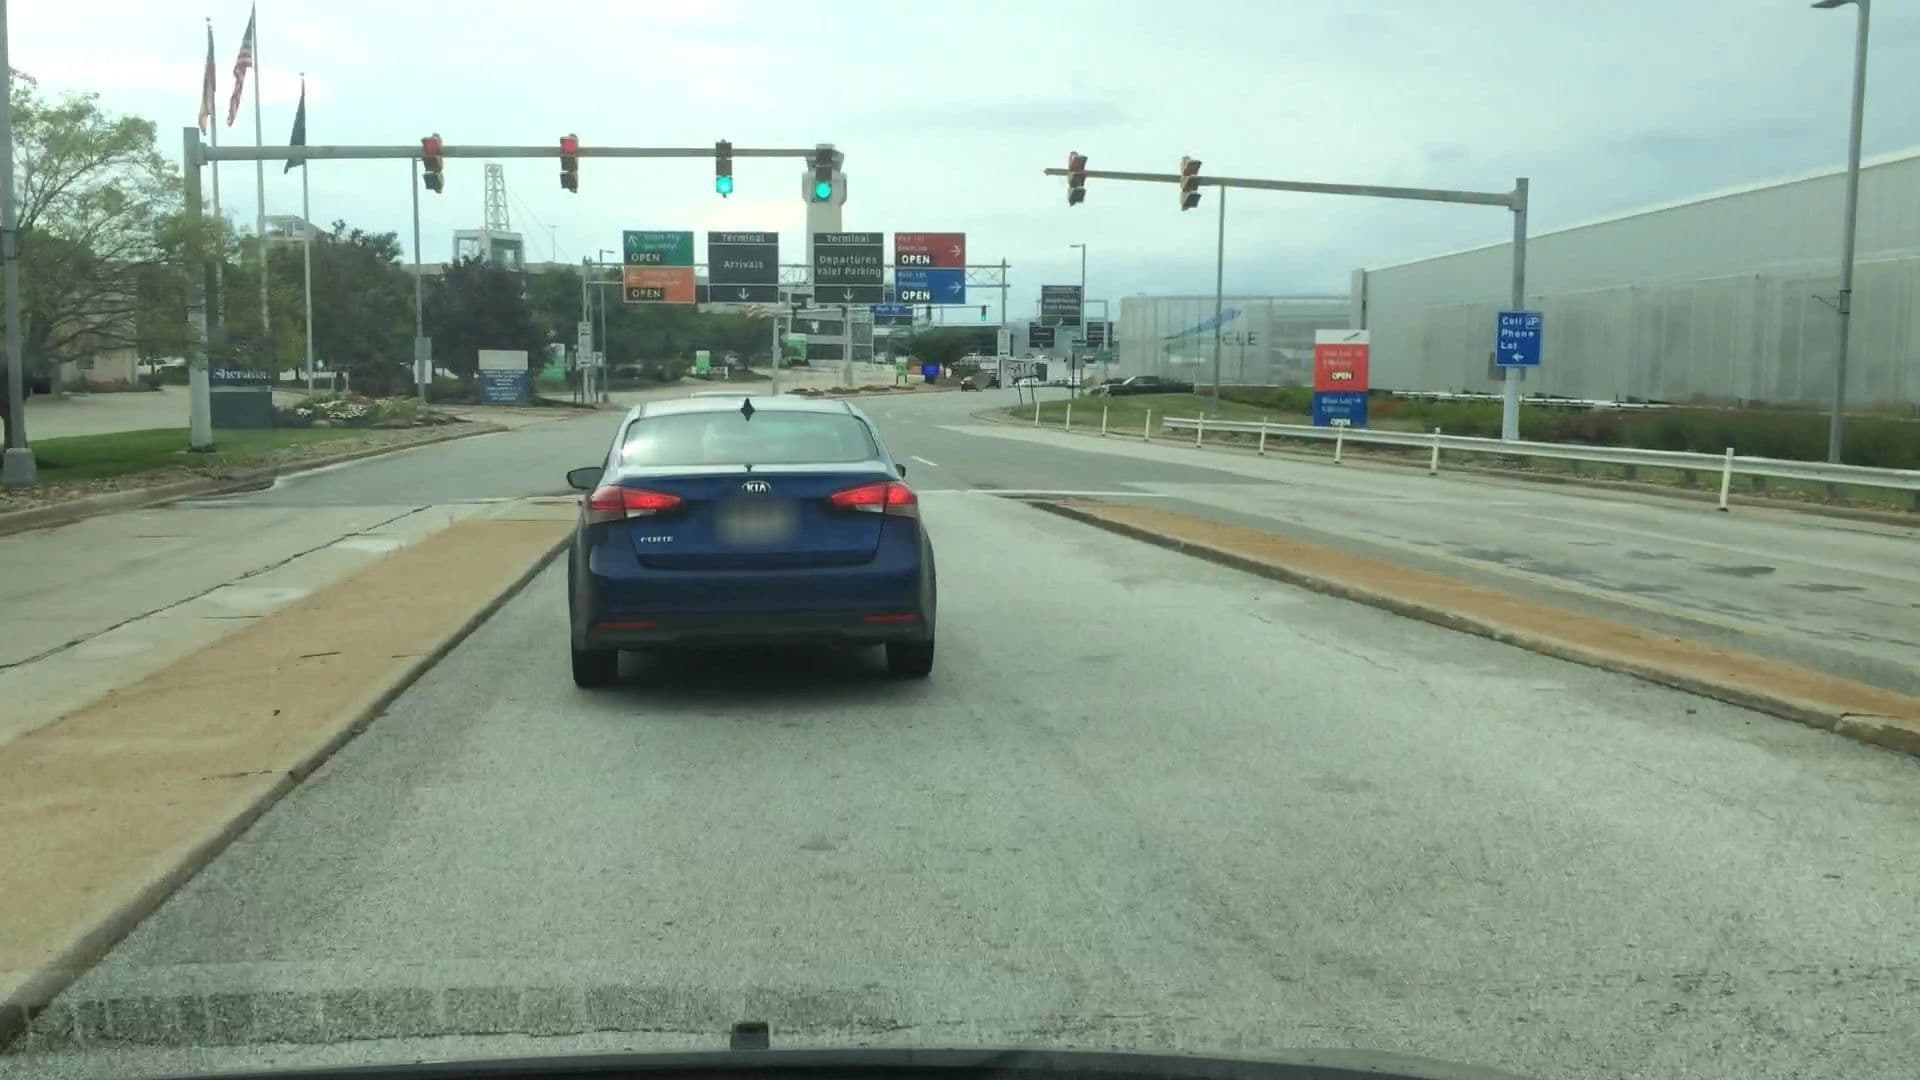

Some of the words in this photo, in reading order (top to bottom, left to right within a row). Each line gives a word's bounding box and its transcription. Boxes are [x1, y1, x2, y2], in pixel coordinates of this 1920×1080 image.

[721, 233, 765, 242] Terminal
[827, 233, 870, 243] Terminal
[631, 252, 661, 262] OPEN
[819, 255, 877, 266] Departures
[901, 254, 930, 264] OPEN
[723, 260, 764, 269] Arrivals
[816, 266, 841, 276] Valet
[844, 266, 881, 278] Parking
[632, 289, 661, 298] OPEN
[901, 290, 931, 300] OPEN
[1502, 316, 1523, 326] Cell
[1501, 328, 1534, 338] Phone
[1500, 341, 1518, 350] Lot
[1331, 371, 1353, 380] OPEN
[1330, 418, 1351, 426] OPEN
[745, 482, 768, 493] KIA
